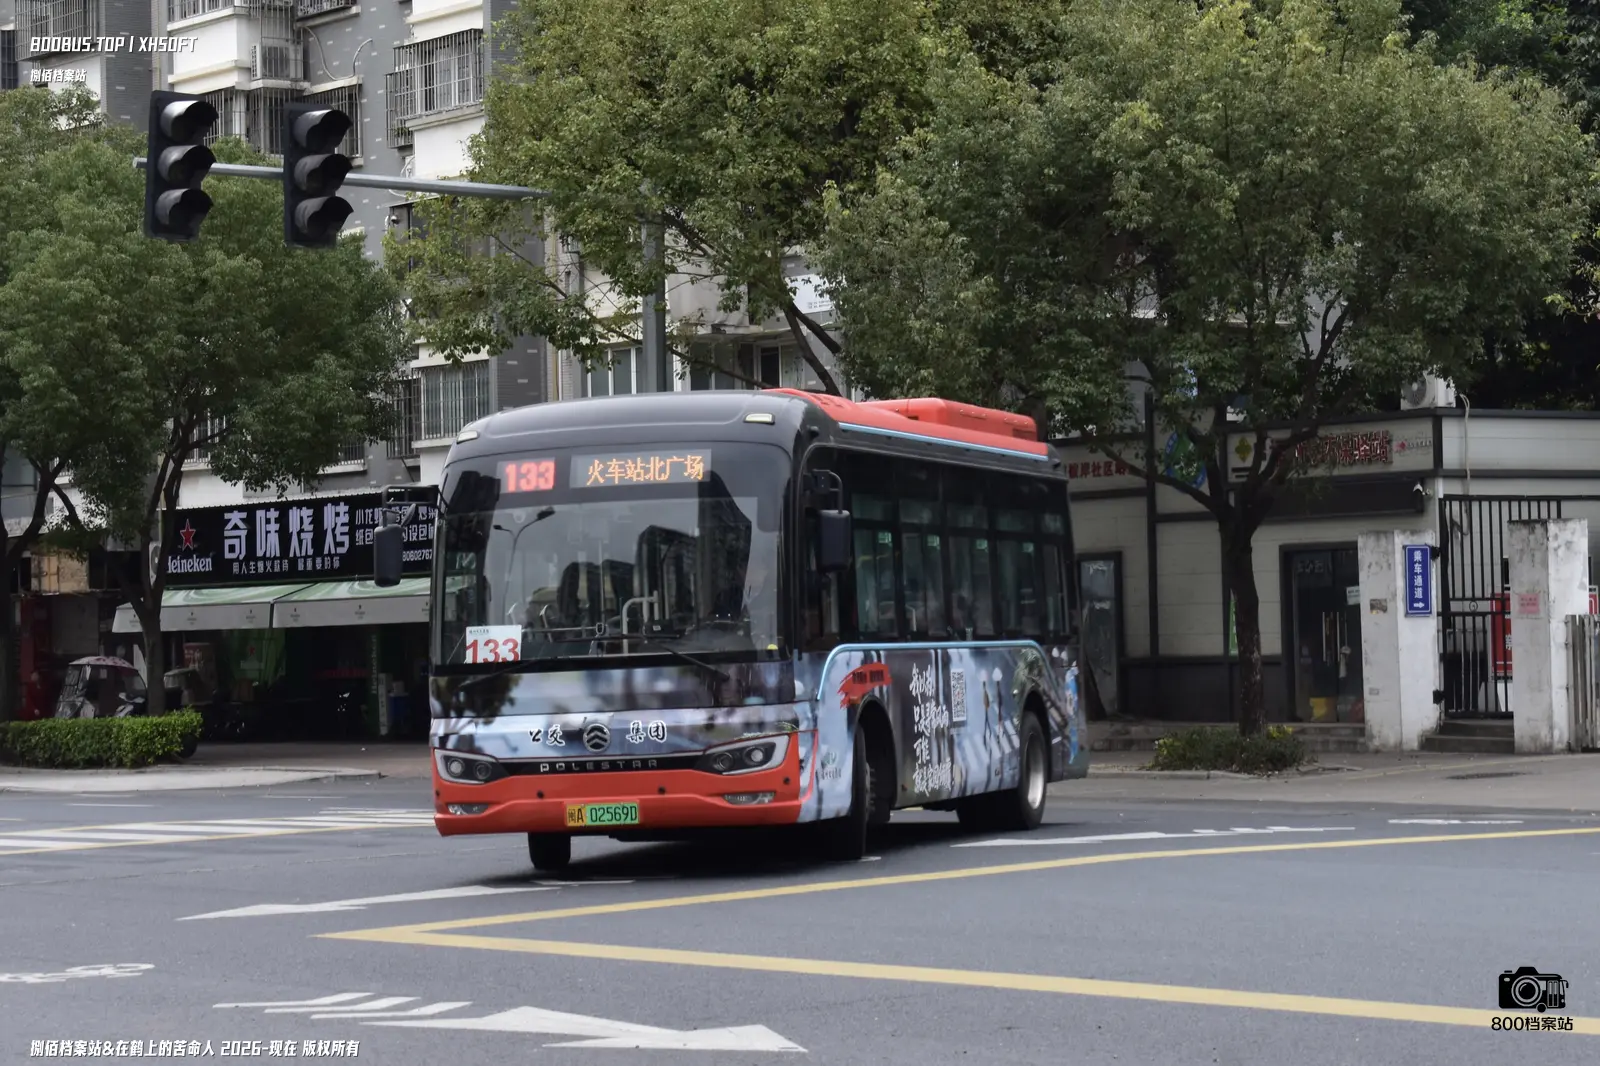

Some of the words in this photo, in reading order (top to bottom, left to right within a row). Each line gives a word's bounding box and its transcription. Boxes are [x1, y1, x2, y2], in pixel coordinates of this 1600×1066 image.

[505, 460, 556, 493] 133
[587, 455, 705, 486] 火车站北广场
[223, 502, 350, 560] 奇味烧烤
[1413, 550, 1423, 599] 乘车通道
[465, 638, 520, 664] 133
[529, 724, 565, 746] 公交
[626, 719, 667, 743] 集团
[540, 759, 658, 772] POLESTAR
